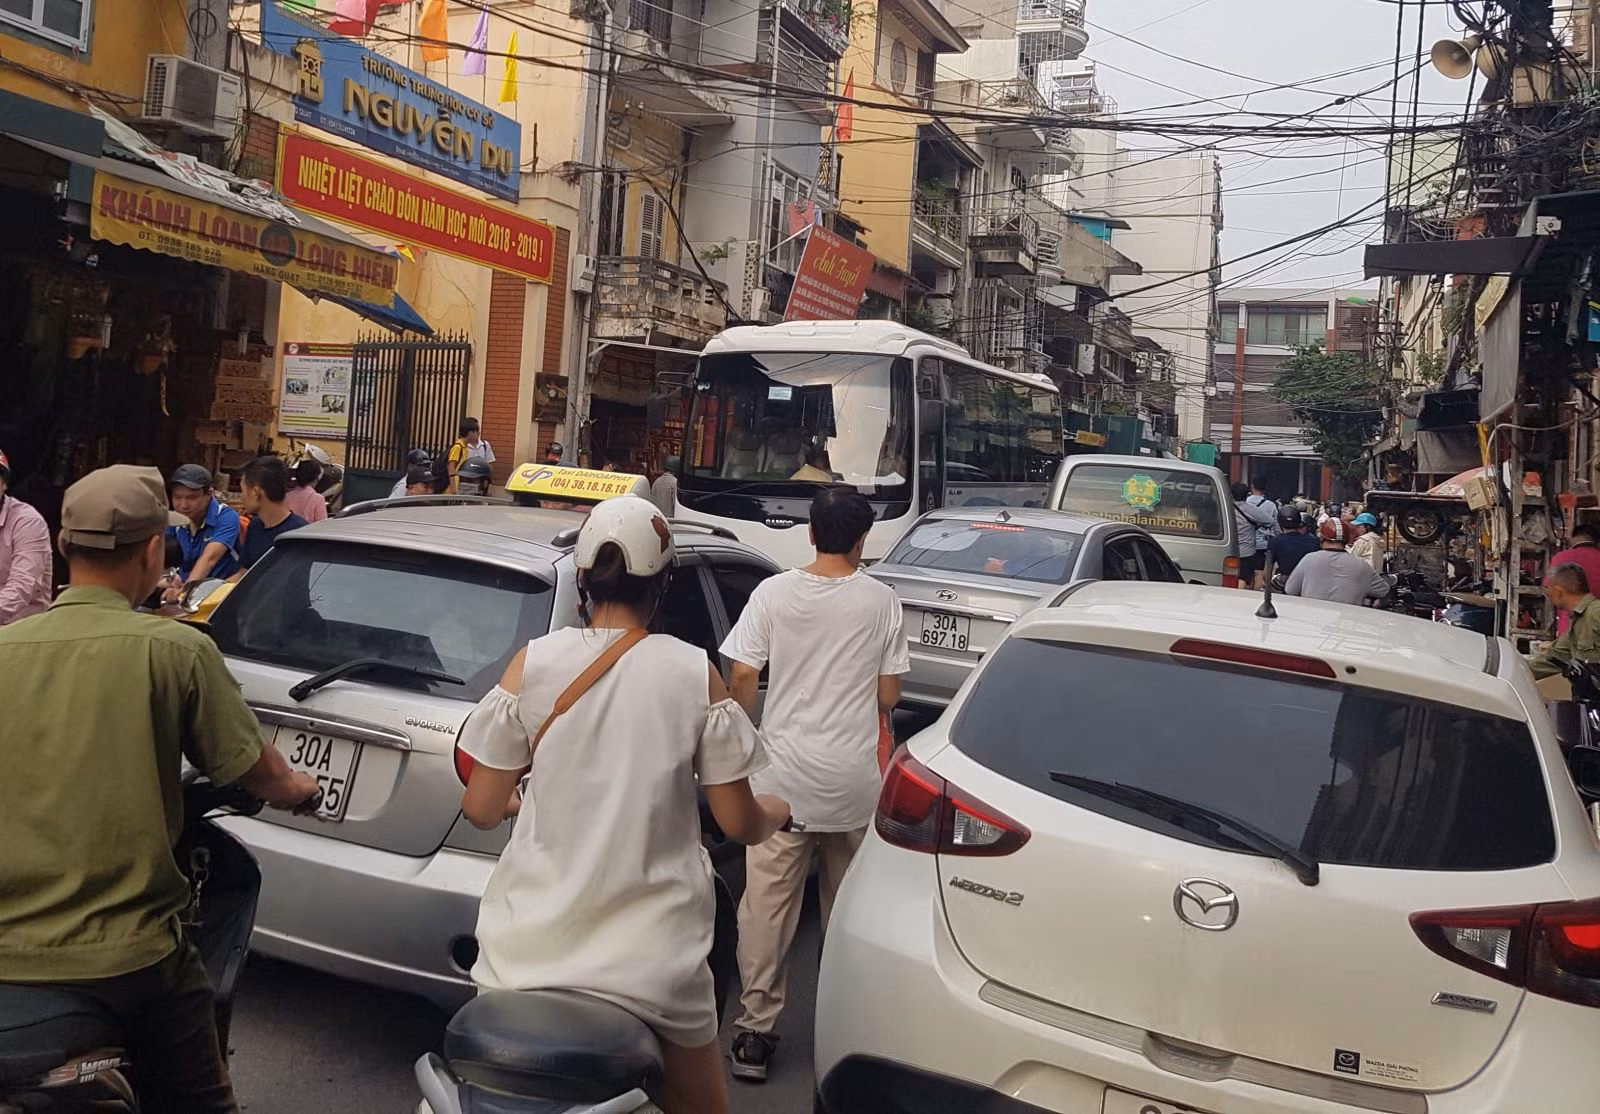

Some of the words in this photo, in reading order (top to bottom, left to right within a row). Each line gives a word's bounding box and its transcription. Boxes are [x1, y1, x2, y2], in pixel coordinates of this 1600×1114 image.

[298, 156, 336, 200] NHIỆT
[337, 166, 363, 209] LIỆT
[364, 178, 395, 216] CHÀO
[396, 187, 420, 224] ĐÓN
[421, 196, 445, 232] NĂM
[446, 207, 467, 242] HỌC
[468, 213, 487, 246] MỚI
[488, 222, 511, 252] 2018
[517, 232, 538, 261] 2019
[99, 184, 191, 237] KHÁNH
[197, 210, 258, 254] LOAN
[295, 239, 348, 278] LONG
[558, 468, 575, 477] Taxi
[550, 477, 571, 489] (04)
[571, 479, 627, 495] 38.18.18.18
[933, 615, 957, 632] 30A
[922, 630, 967, 649] 697.18
[290, 733, 333, 772] 30A
